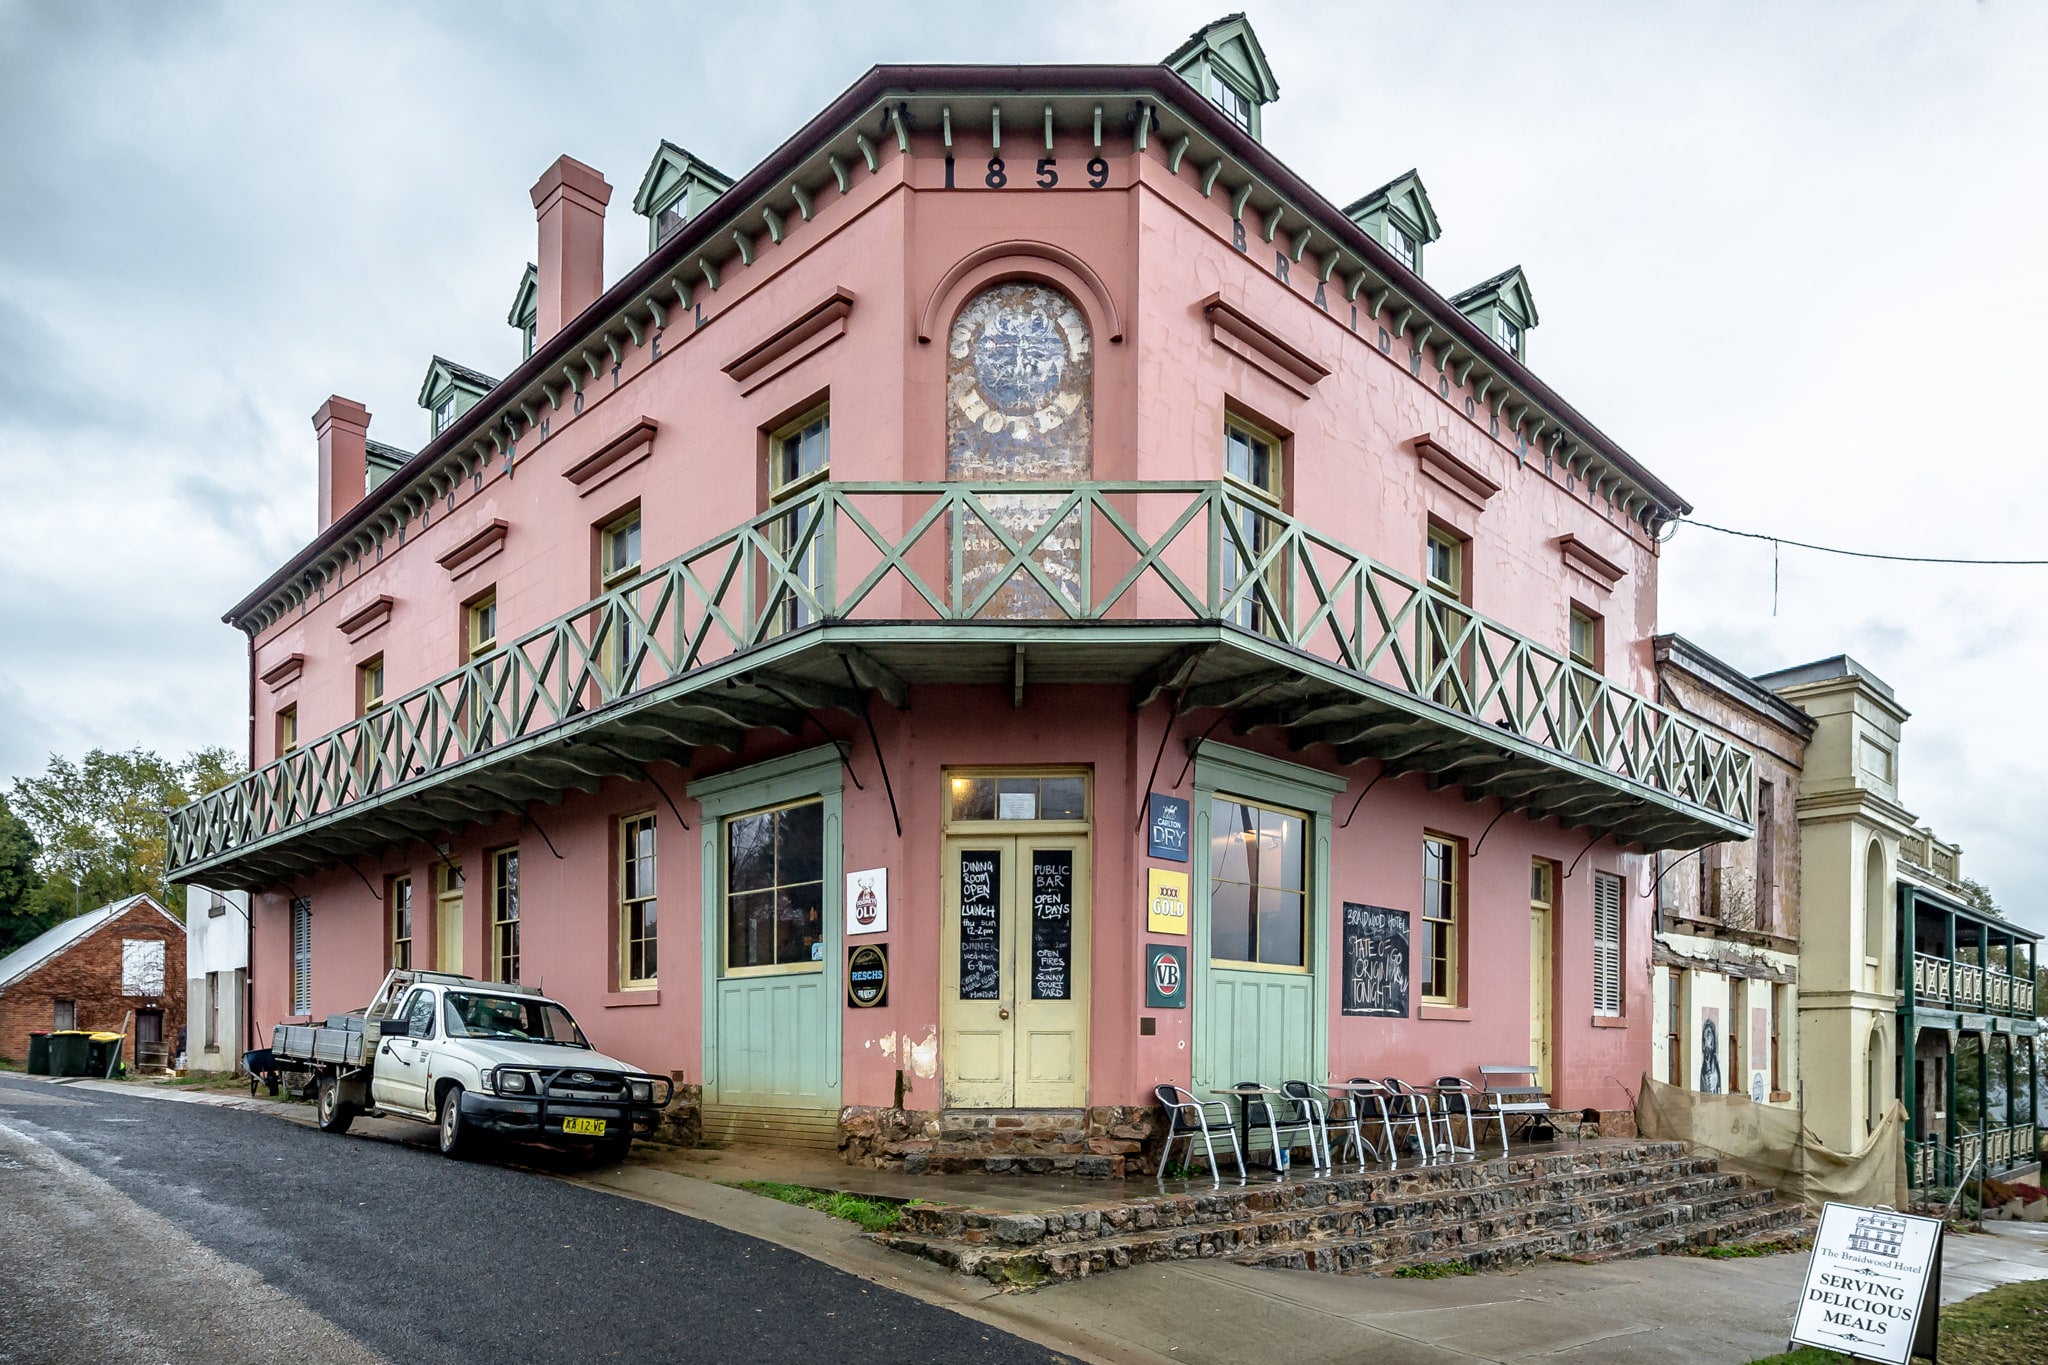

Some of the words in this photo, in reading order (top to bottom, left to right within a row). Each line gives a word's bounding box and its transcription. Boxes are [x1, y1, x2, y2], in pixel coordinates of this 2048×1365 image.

[944, 157, 1109, 190] 1859
[1232, 219, 1500, 440] BRAIDWOOD
[540, 302, 709, 444] HOTEL
[1153, 825, 1186, 848] DRY
[962, 861, 993, 873] DINING
[1034, 864, 1070, 876] PUBLIC
[963, 872, 990, 884] ROOM
[1036, 875, 1065, 887] BAR
[963, 884, 990, 895] OPEN
[1159, 886, 1178, 898] XXXX
[1034, 893, 1061, 904] OPEN
[856, 905, 877, 920] OLD
[961, 904, 995, 918] LUNCH
[1034, 904, 1043, 917] 7
[1045, 903, 1070, 914] DAYS
[1152, 898, 1185, 917] GOLD
[1036, 949, 1060, 958] OPEN
[1348, 935, 1377, 959] STATE
[1041, 957, 1066, 967] FIRES
[852, 970, 883, 981] RESCHS
[1035, 972, 1065, 982] SUNNY
[1156, 964, 1179, 986] VB
[1820, 1247, 1839, 1259] The
[1841, 1251, 1893, 1269] Braidwood
[1893, 1261, 1922, 1274] Hotel
[1819, 1273, 1905, 1300] SERVING
[1808, 1288, 1913, 1321] DELICIOUS
[1823, 1309, 1888, 1334] MEALS
